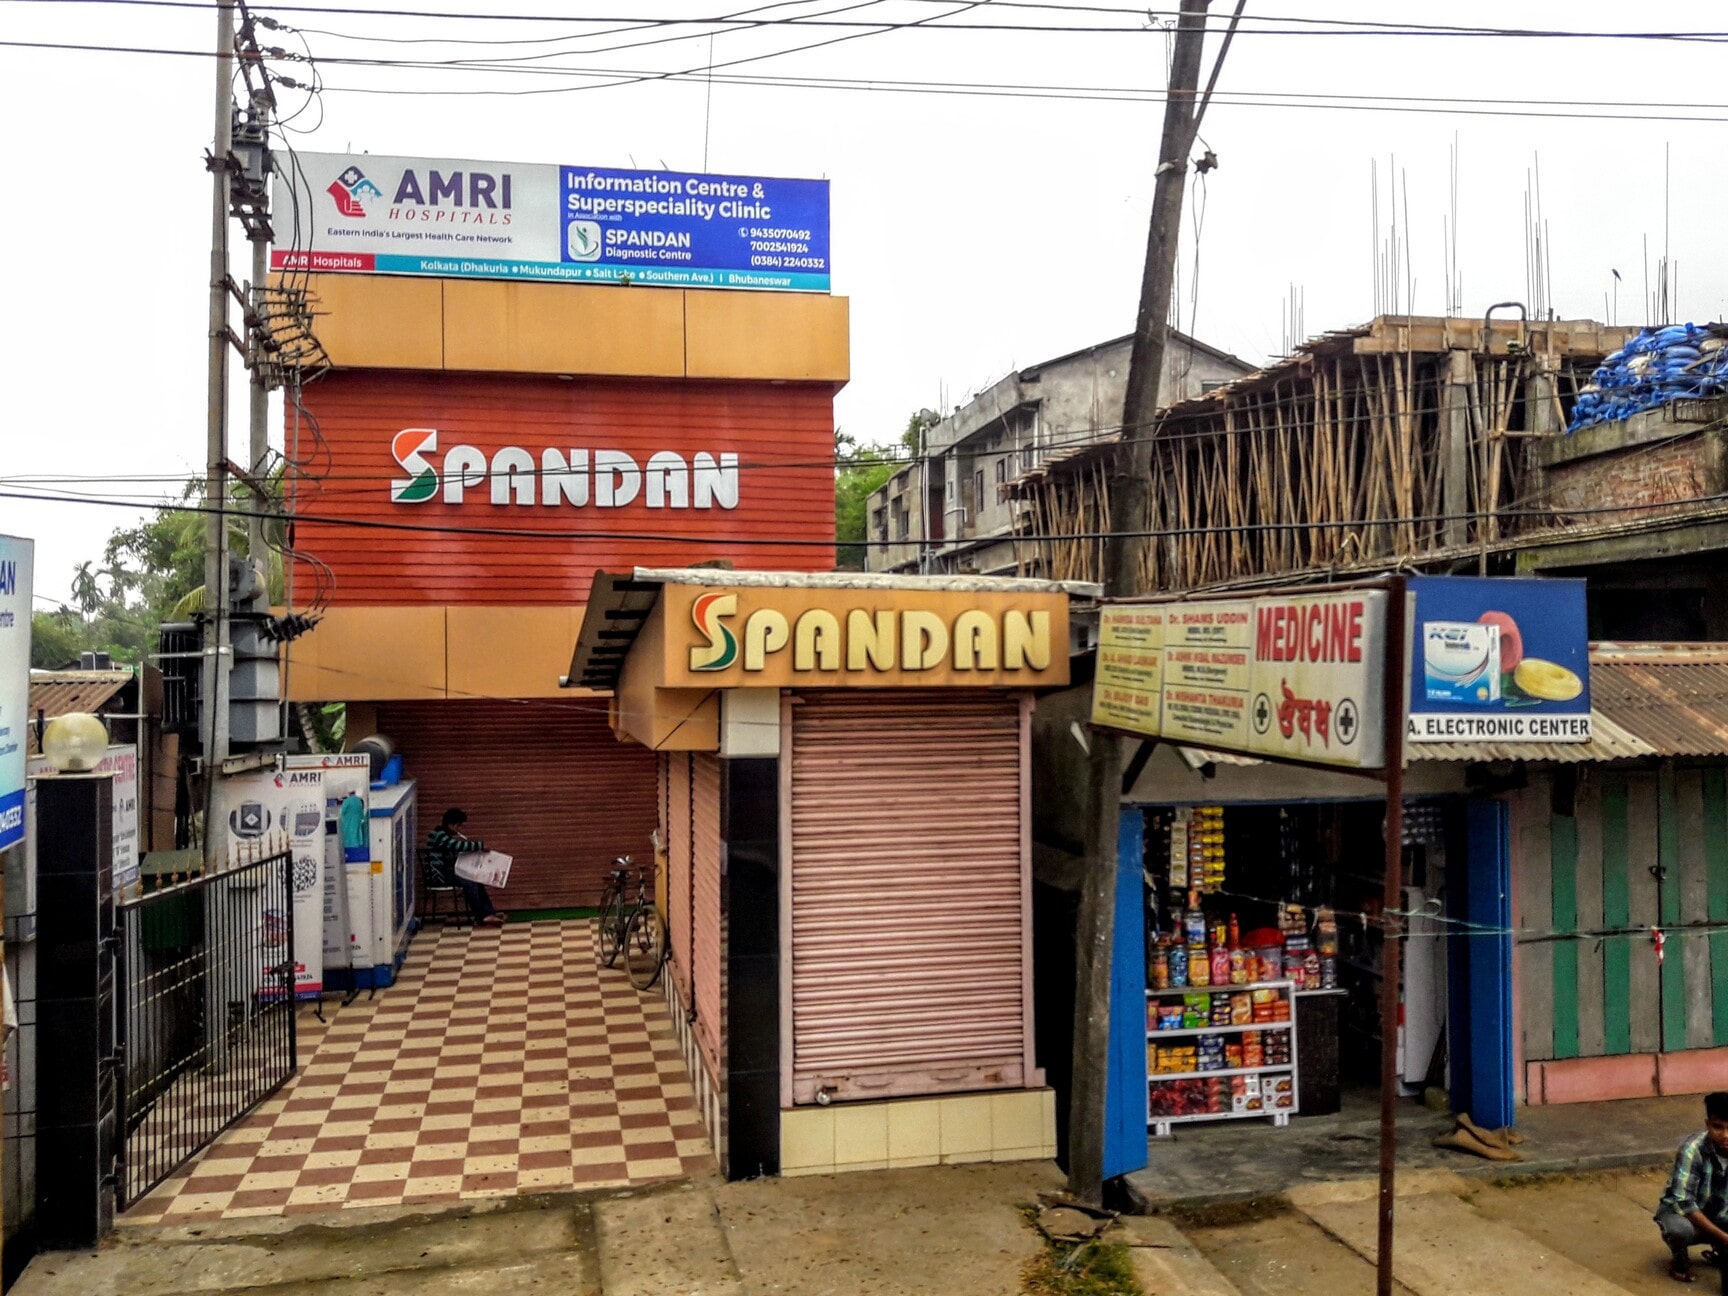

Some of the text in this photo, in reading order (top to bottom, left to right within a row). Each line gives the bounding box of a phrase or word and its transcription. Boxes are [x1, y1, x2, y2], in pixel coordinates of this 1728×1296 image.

[393, 168, 511, 209] AMRI
[567, 172, 765, 199] Information Centre &
[567, 193, 772, 220] Superspeciality Clinic
[388, 208, 512, 225] HOSPITALS
[327, 227, 513, 244] Eastern India's Largest Health Care Network
[605, 228, 691, 248] SPANDAN
[749, 227, 811, 240] 9435070492
[605, 246, 692, 261] Diagnostic Centre
[750, 241, 808, 254] 7002541924
[313, 256, 362, 268] Hospitals
[750, 255, 825, 269] (0384) 2240332
[420, 260, 459, 272] Kolkata
[460, 261, 508, 273] (Dhakuria
[520, 264, 582, 277] Mukundapur
[593, 268, 611, 278] Salt
[646, 270, 689, 281] Southern
[691, 272, 714, 283] Ave.)
[728, 273, 791, 287] Bhubaneswar
[391, 428, 740, 510] SPANDAN
[689, 592, 1051, 672] SPANDAN
[1255, 602, 1364, 663] MEDICINE
[1426, 719, 1524, 735] ELECTRONIC
[1528, 719, 1590, 736] CENTER
[335, 756, 365, 766] AMRI
[290, 772, 321, 782] AMRI
